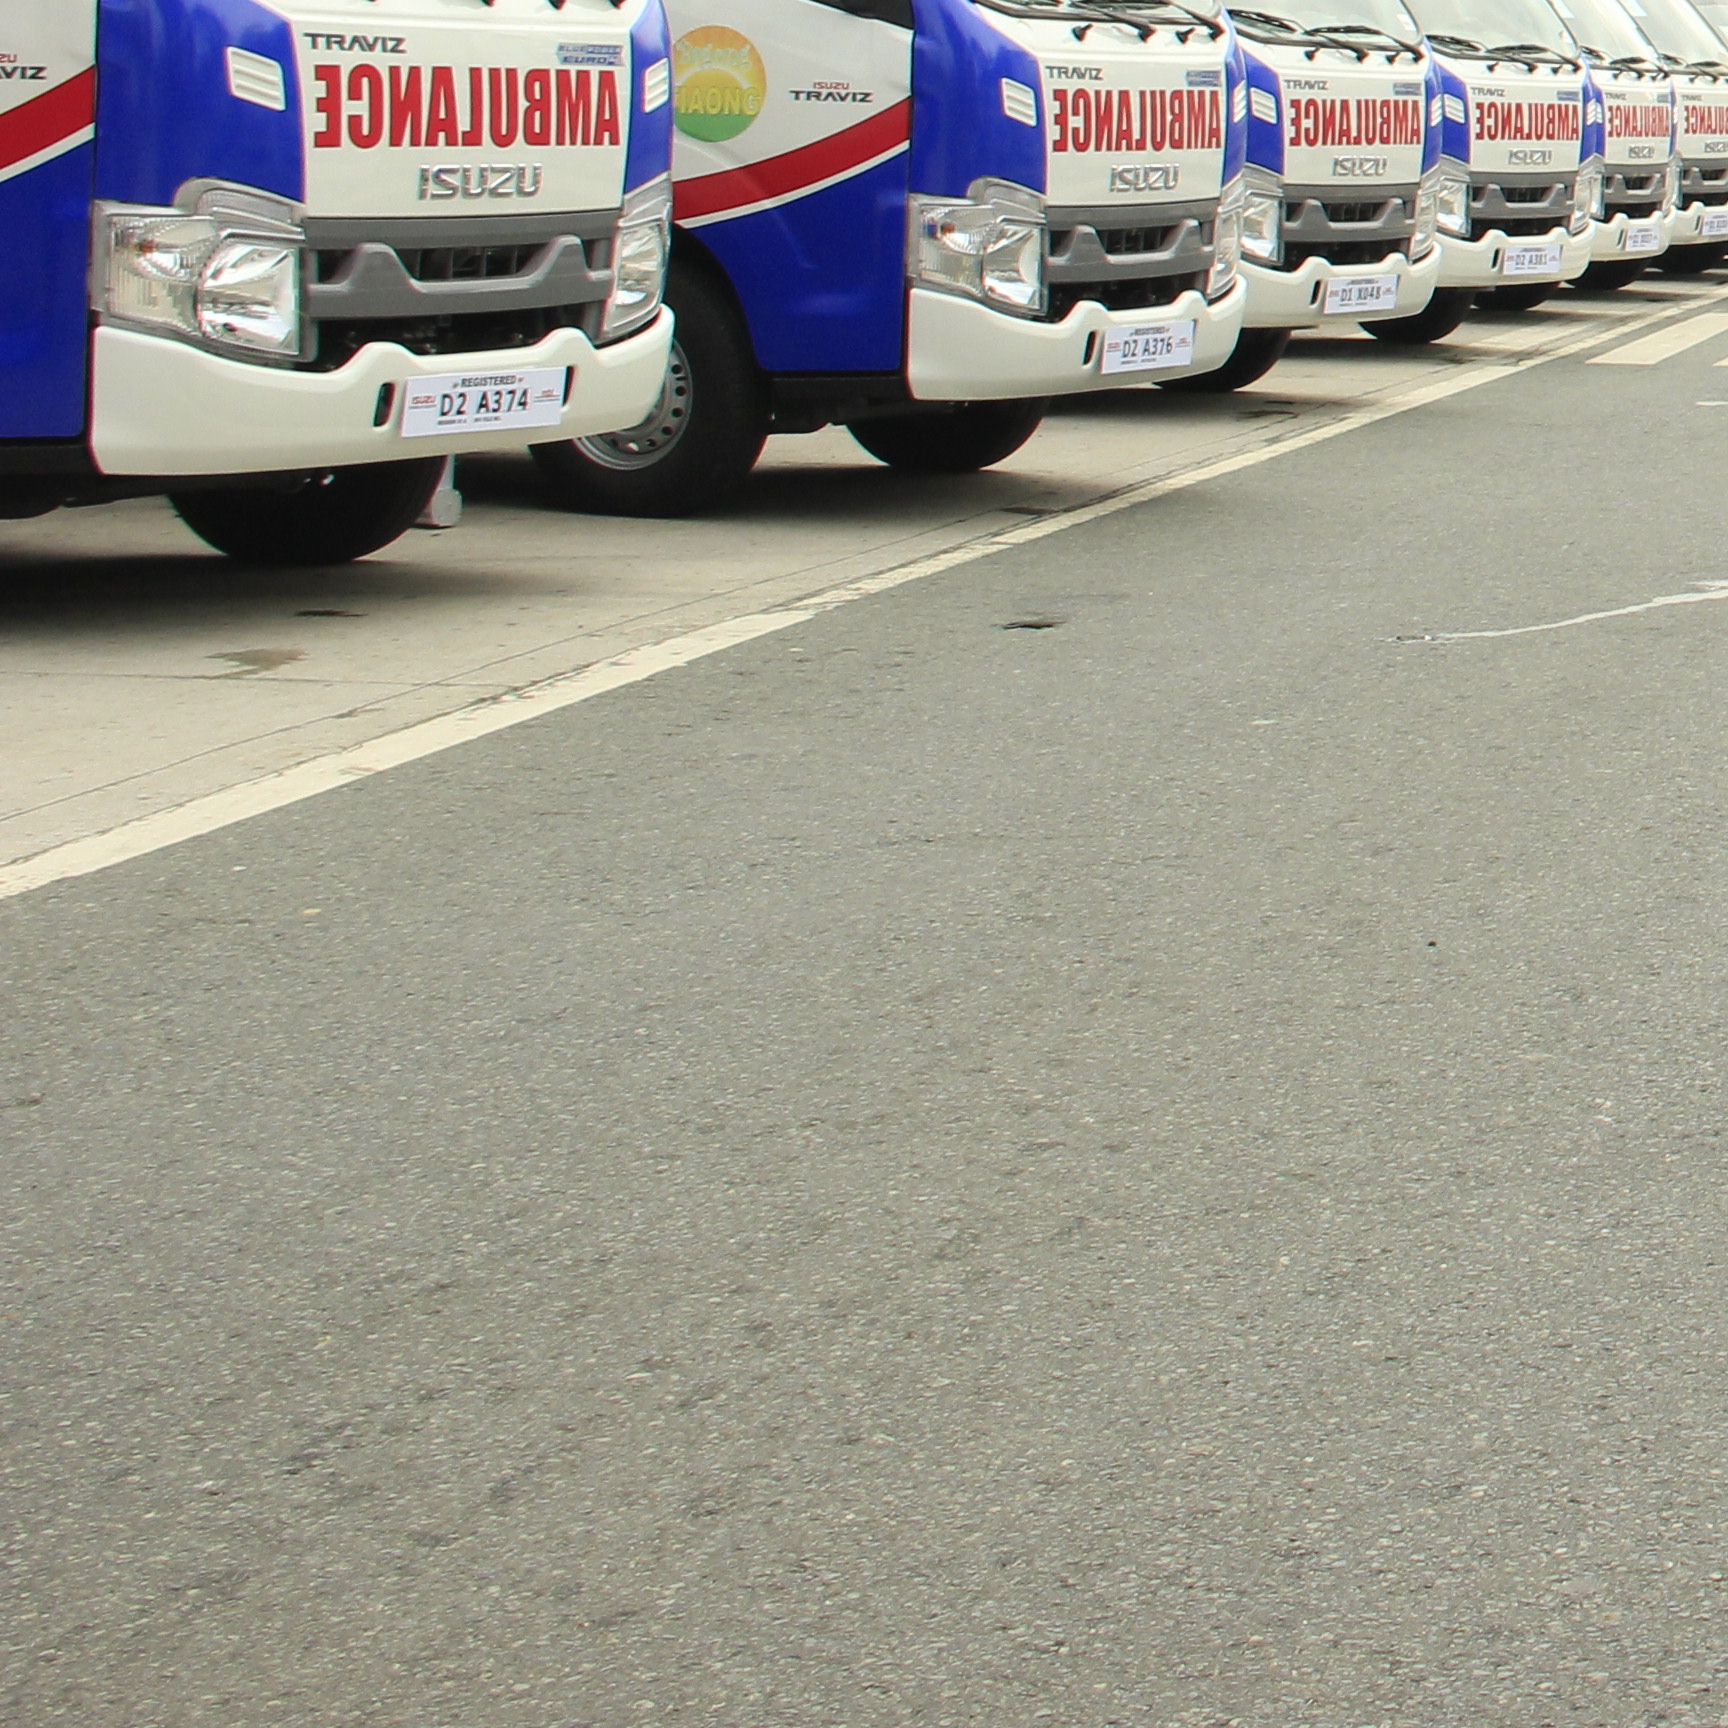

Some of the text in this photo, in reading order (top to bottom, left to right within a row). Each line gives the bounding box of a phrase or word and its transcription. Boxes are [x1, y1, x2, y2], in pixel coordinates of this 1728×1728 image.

[303, 32, 407, 54] TRAVIZ
[1045, 65, 1104, 80] TRAVIZ
[813, 82, 850, 90] ISUZU
[1284, 79, 1328, 90] TRAVIZ
[1471, 87, 1505, 97] TRAVIZ
[790, 90, 873, 103] TRAVIZ
[1508, 149, 1552, 165] ISUZU
[1332, 154, 1388, 177] ISUZU
[418, 162, 542, 200] ISUZU
[1110, 163, 1180, 192] ISUZU
[1122, 336, 1173, 358] D2 A376
[461, 375, 516, 388] REGISTERED
[440, 387, 530, 416] D2 A374
